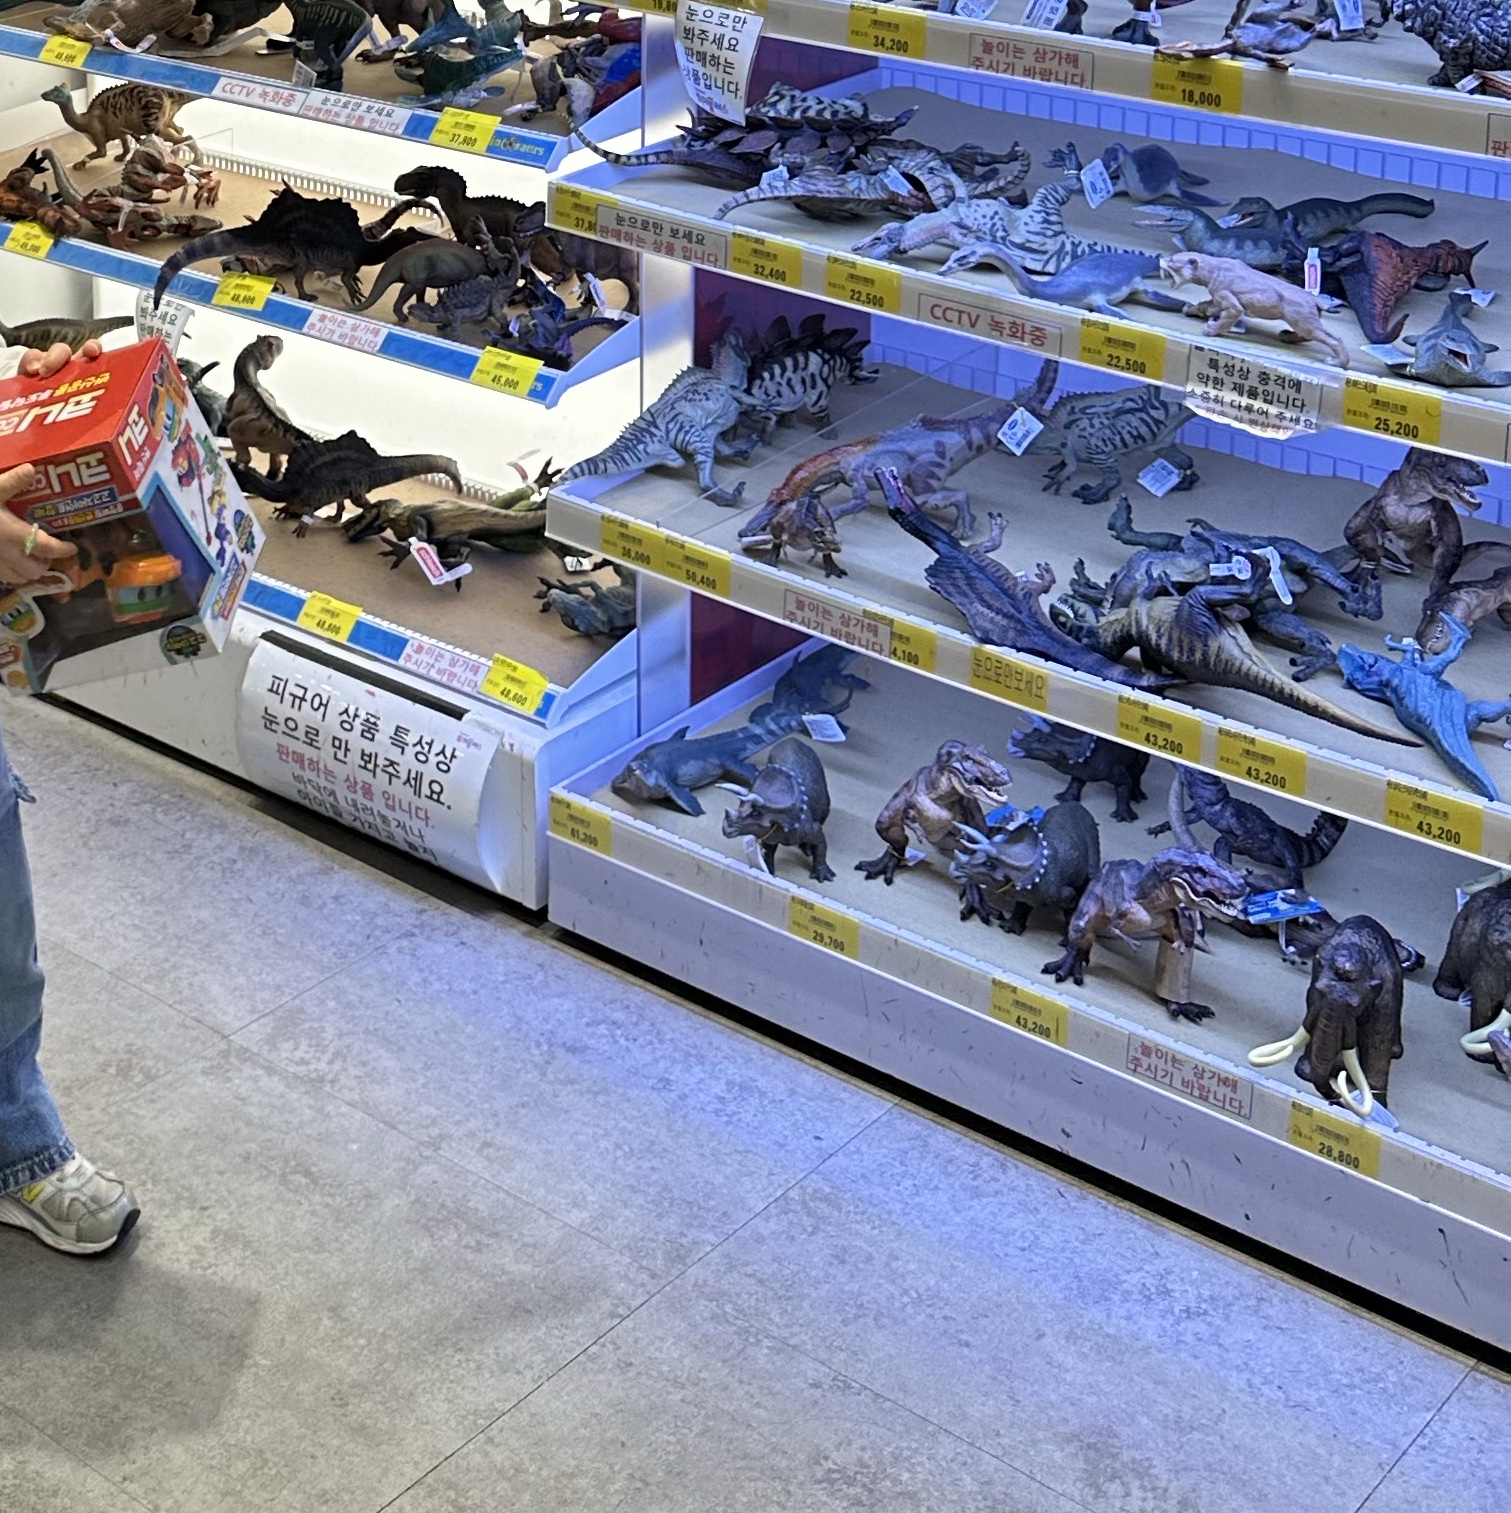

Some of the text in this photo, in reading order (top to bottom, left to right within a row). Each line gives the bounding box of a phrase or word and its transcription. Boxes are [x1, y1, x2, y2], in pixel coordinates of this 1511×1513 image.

[684, 4, 748, 34] 눈으로만
[682, 26, 740, 54] 봐주세요
[872, 33, 909, 54] 34,200
[980, 39, 1080, 69] 놀이는 삼가해
[221, 81, 297, 109] CCTV 녹화중
[320, 95, 395, 119] 눈으로만 보세요
[1180, 88, 1222, 108] 18,000
[448, 132, 478, 148] 37,800
[598, 224, 676, 260] 판매하는 상품
[614, 213, 706, 247] 눈으로만 보세요
[753, 263, 787, 283] 32,400
[849, 289, 885, 309] 22,500
[930, 304, 1049, 348] CCTV 녹화중
[1106, 357, 1147, 375] 22,500
[1207, 357, 1302, 395] 특성상 충격에
[490, 374, 520, 390] 45,000
[1196, 372, 1225, 391] 약한
[18, 389, 105, 433] 코니
[1186, 389, 1269, 419] 소중히 다루어
[1374, 416, 1419, 439] 25,200
[51, 452, 110, 494] 코니
[685, 569, 717, 590] 50,400
[786, 610, 828, 637] 주시기
[793, 596, 879, 639] 놀이는 삼가해
[267, 674, 458, 775] 피규어 상품 특성상
[1144, 731, 1183, 755] 43,200
[261, 707, 452, 811] 눈으로 만 봐주세요.
[276, 742, 436, 829] 판매하는 상품 입니다.
[1245, 765, 1286, 789] 43,200
[1416, 820, 1461, 846] 43,200
[812, 929, 845, 952] 29,700
[1015, 1014, 1052, 1039] 43,200
[1128, 1055, 1175, 1088] 주시기
[1139, 1040, 1238, 1095] 놀이는 삼가해
[1317, 1141, 1361, 1170] 28,800
